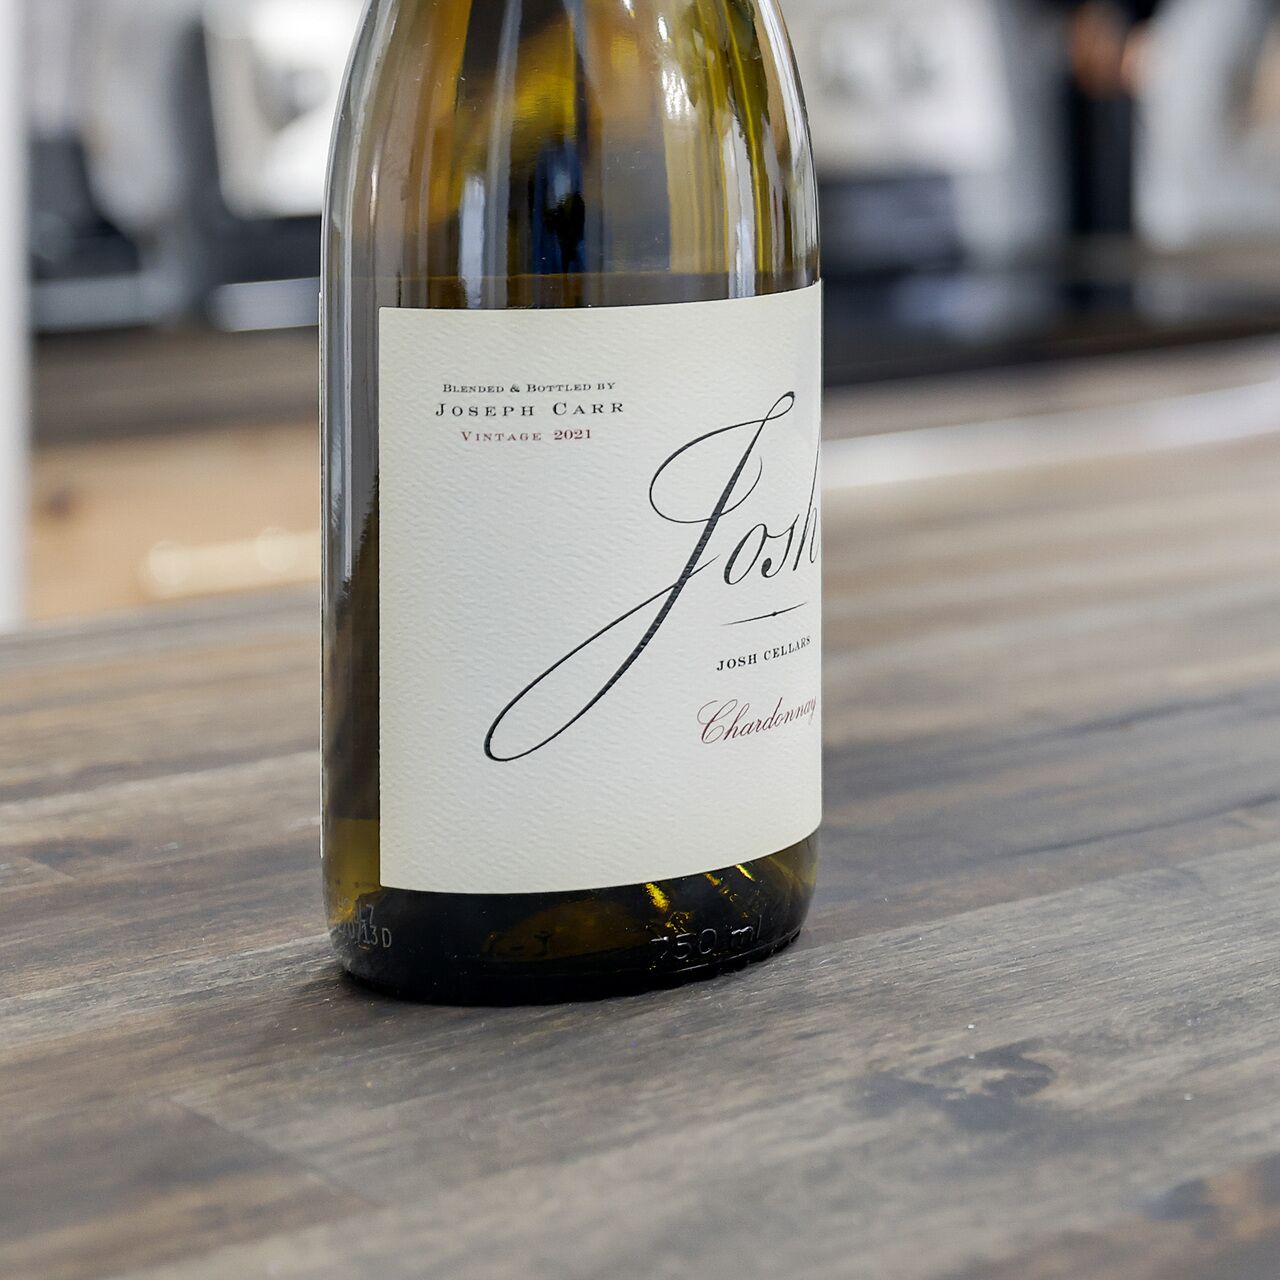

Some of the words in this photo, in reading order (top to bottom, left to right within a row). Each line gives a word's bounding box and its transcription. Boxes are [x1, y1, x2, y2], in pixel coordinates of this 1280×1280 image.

[442, 383, 505, 393] BLENDED
[509, 383, 521, 393] &
[526, 383, 592, 393] BOTTLED
[596, 382, 616, 391] BY
[435, 402, 535, 417] JOSEPH
[552, 401, 624, 416] CARR
[460, 431, 542, 442] VINTAGE
[553, 429, 592, 441] 2021
[484, 391, 822, 762] Josh
[715, 653, 758, 672] JOSH
[763, 635, 811, 661] CELLARS
[696, 695, 817, 745] Chardonnay
[650, 927, 718, 961] 750
